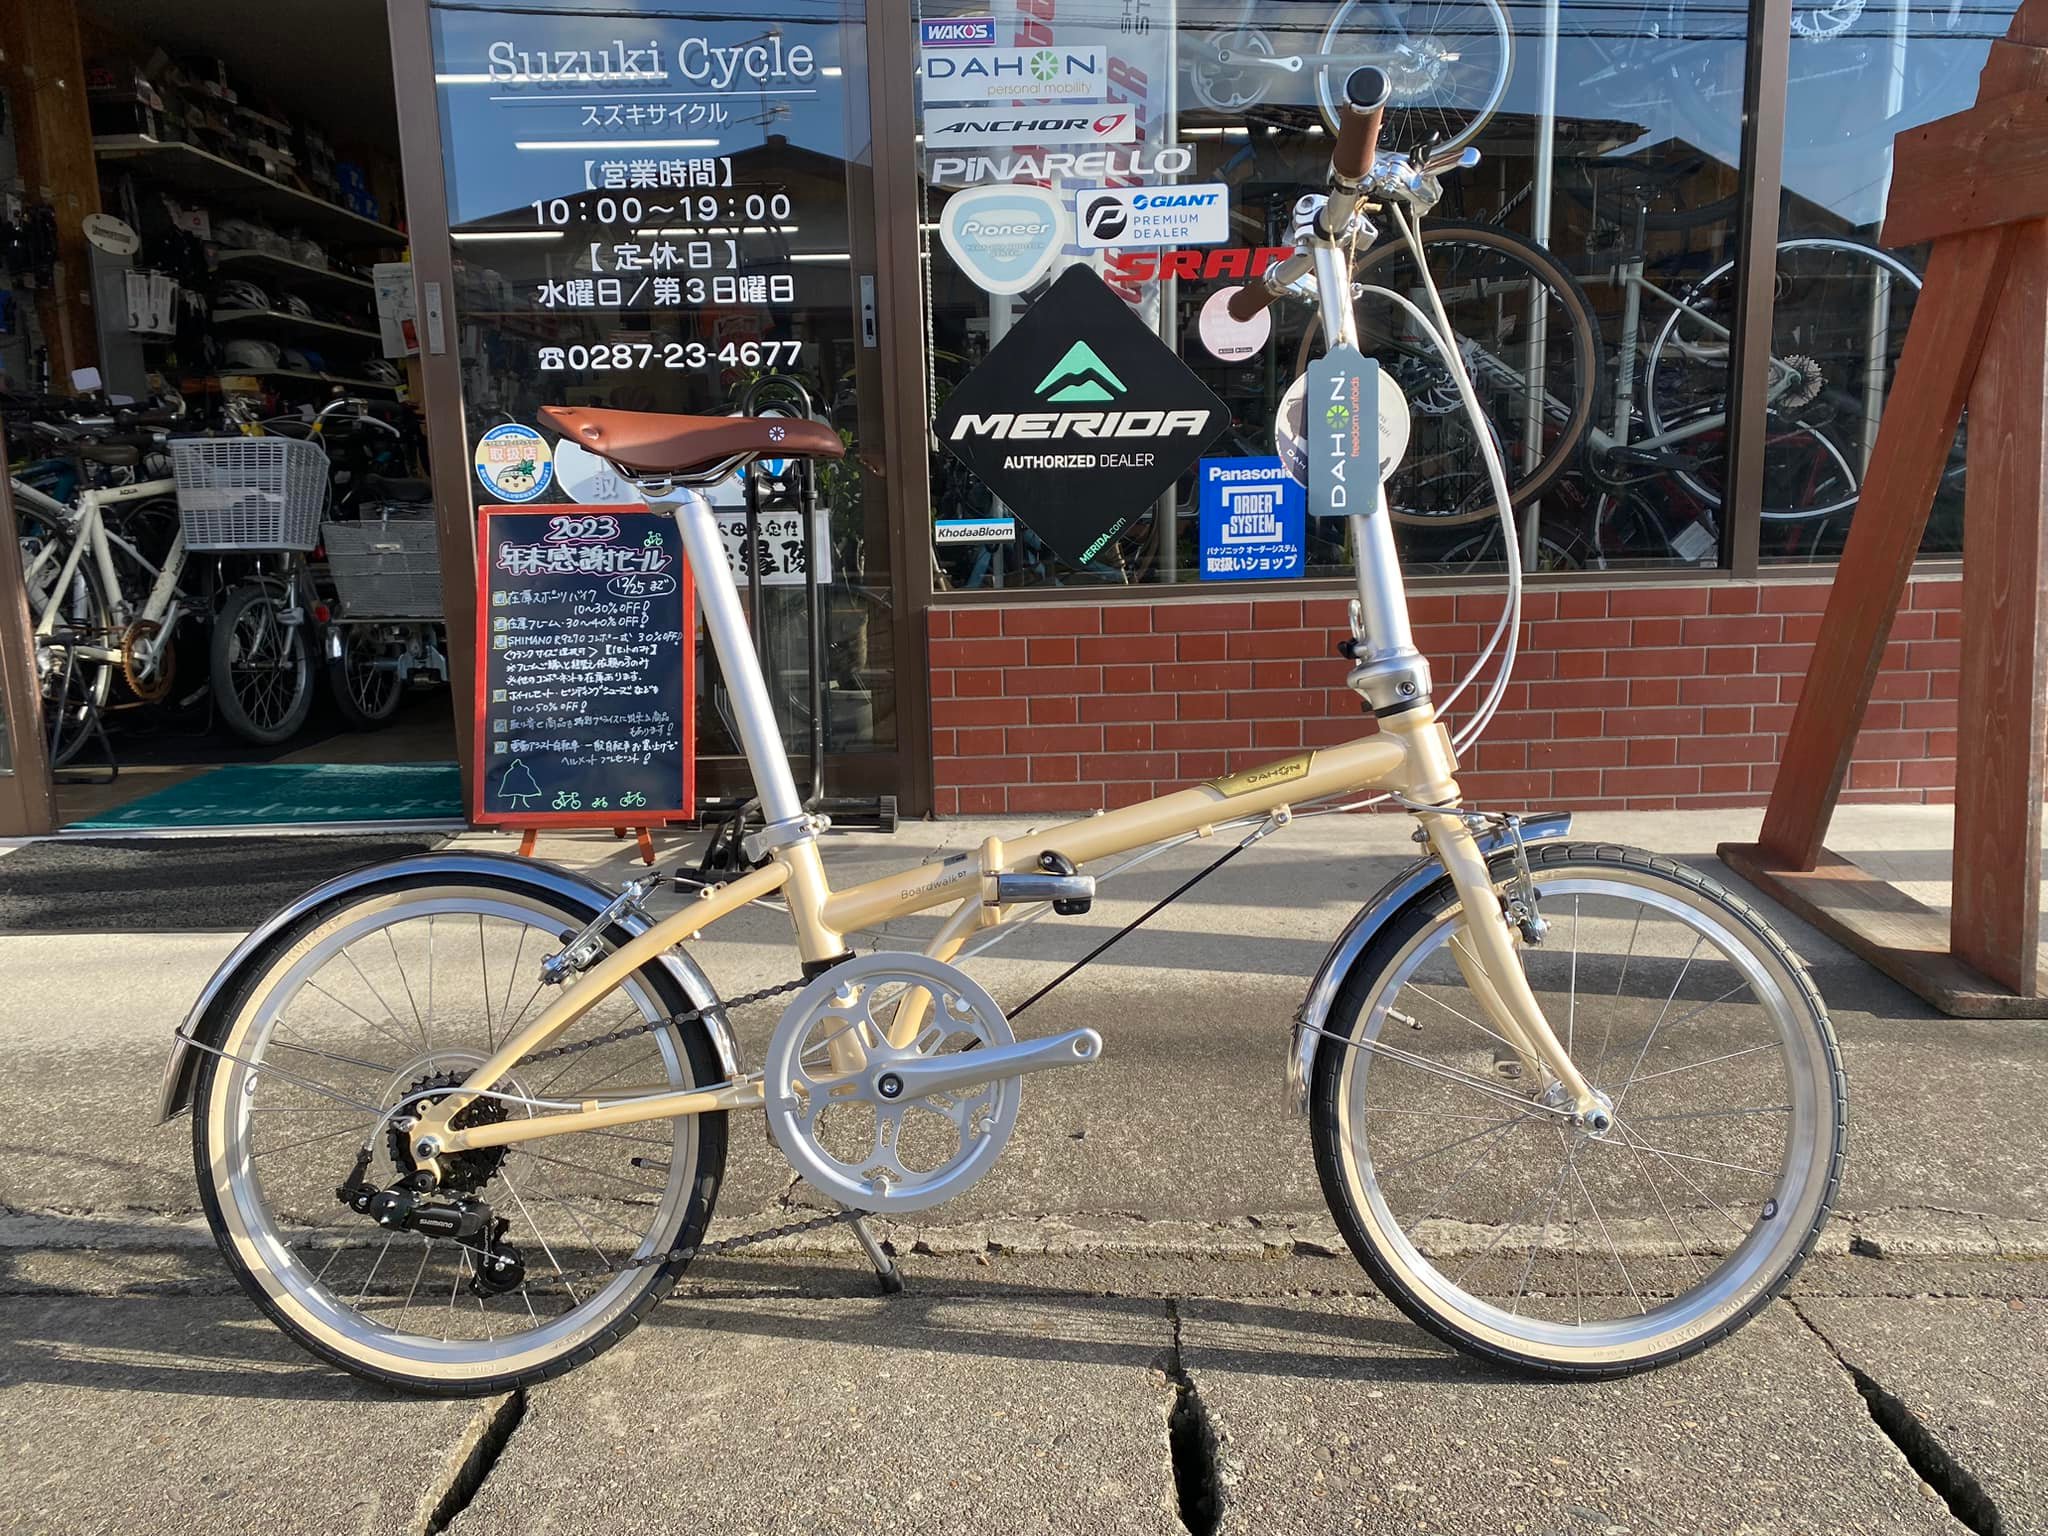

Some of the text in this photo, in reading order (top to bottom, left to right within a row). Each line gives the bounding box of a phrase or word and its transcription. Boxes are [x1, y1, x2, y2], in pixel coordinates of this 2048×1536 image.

[487, 36, 815, 88] Suzuki Cycle
[987, 81, 1091, 97] personal mobility
[580, 102, 729, 126] スズキサイクル
[935, 118, 1089, 135] ANCHOR
[1150, 193, 1219, 208] GIANT
[1133, 213, 1199, 226] PREMIUM
[961, 221, 1051, 237] Pioneer
[1133, 227, 1189, 240] DEALER
[950, 410, 1211, 440] MERIDA
[1352, 376, 1361, 457] freedom unfolds
[1004, 452, 1155, 469] AUTHORIZED DEALER
[1234, 494, 1273, 514] ORDER
[552, 517, 618, 541] 2023
[938, 525, 1013, 539] KhodaaBloom
[1230, 514, 1275, 535] SYSTEM
[1079, 515, 1127, 566] MERIDA.com
[1207, 544, 1298, 555] パナソニック オーダーシステム
[499, 545, 668, 573] 年末感謝セール
[1207, 555, 1298, 573] 取扱いショップ
[616, 576, 645, 594] 12/25
